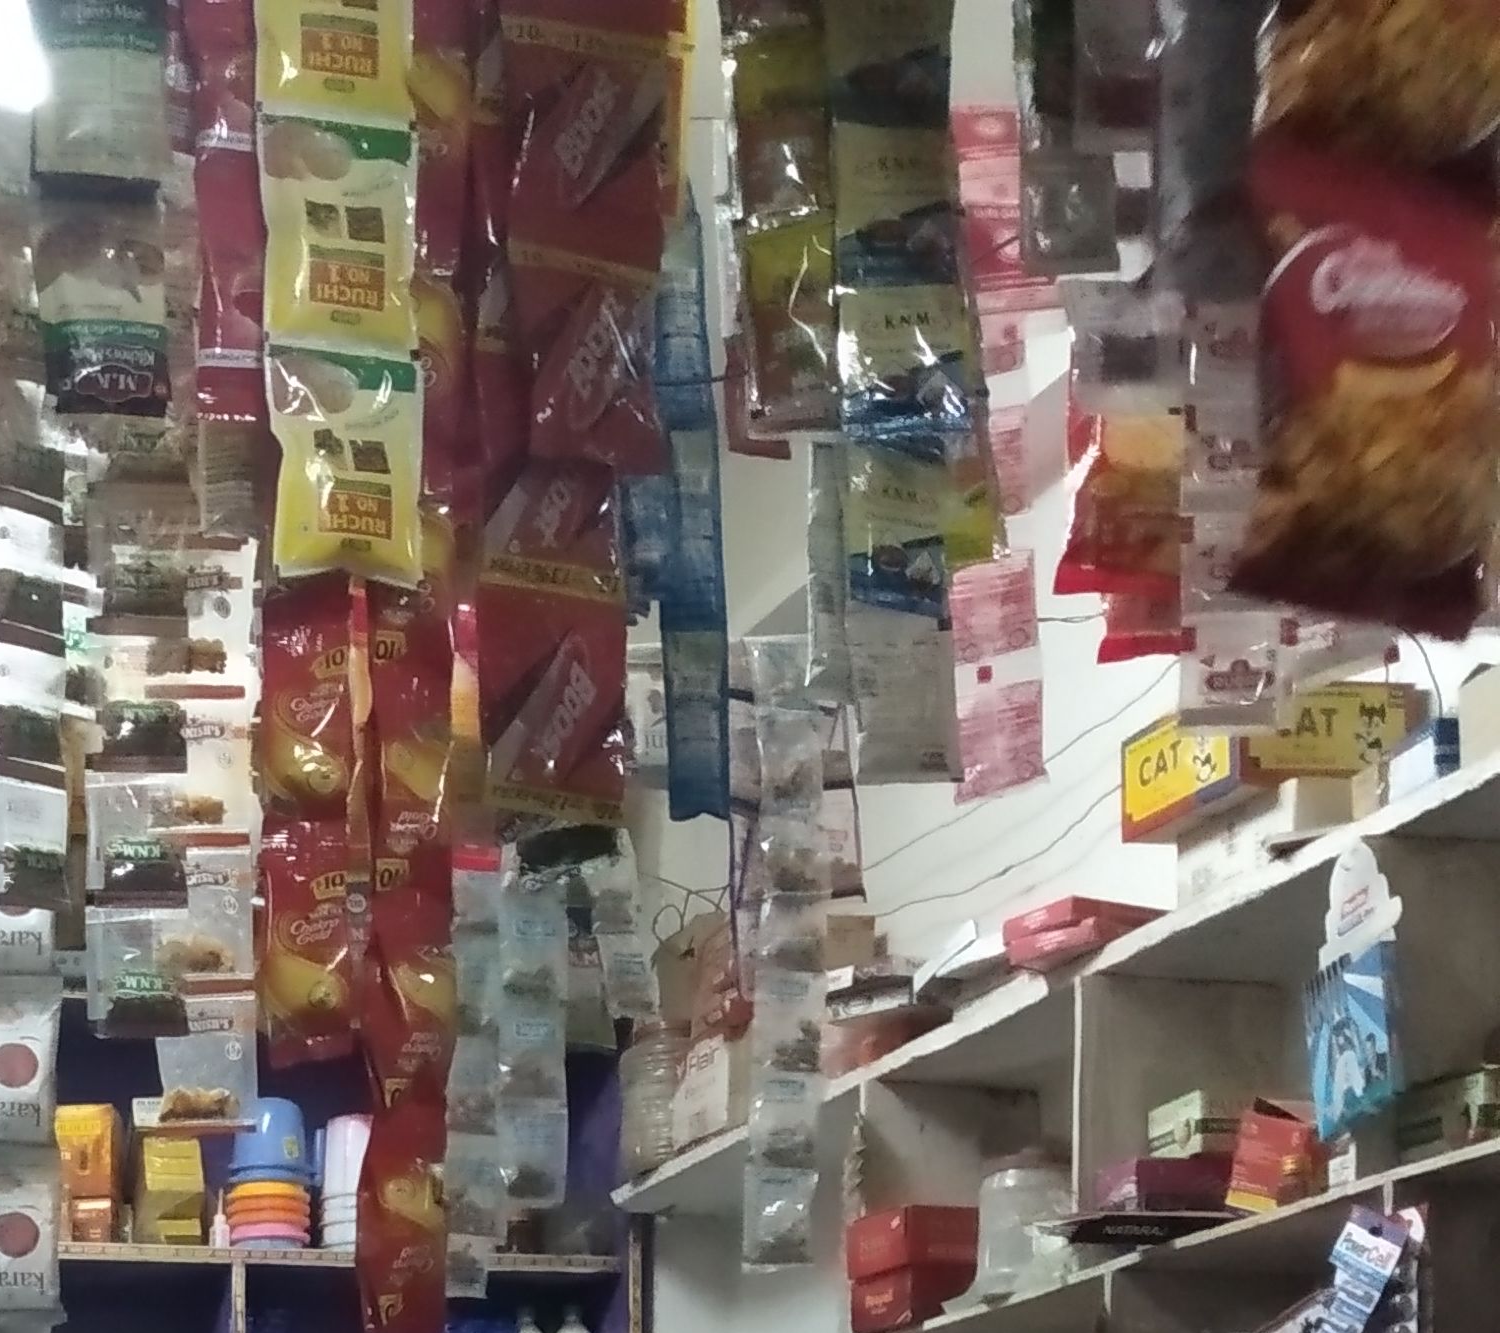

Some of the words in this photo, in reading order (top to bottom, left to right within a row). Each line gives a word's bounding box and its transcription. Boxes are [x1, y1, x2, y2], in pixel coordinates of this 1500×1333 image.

[316, 283, 379, 309] RUCHI
[323, 510, 387, 535] RUCHI
[1277, 706, 1338, 738] AT
[1138, 738, 1182, 787] CAT
